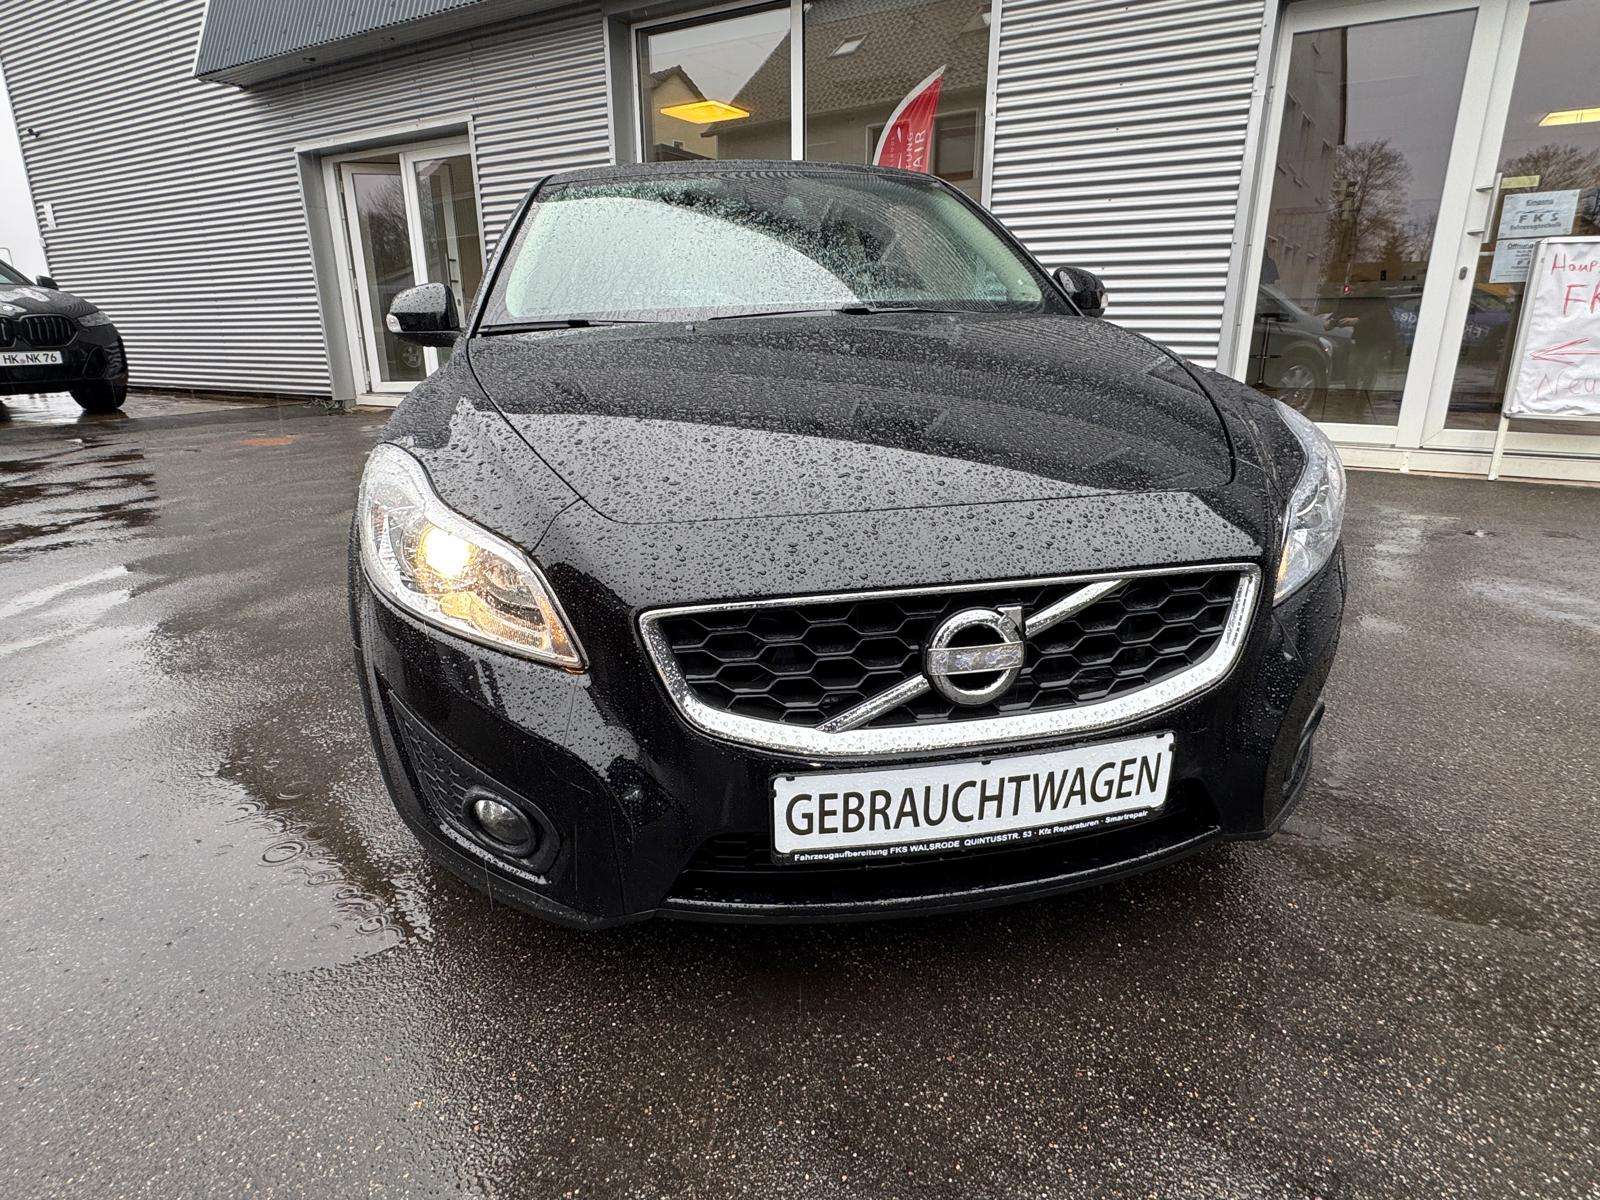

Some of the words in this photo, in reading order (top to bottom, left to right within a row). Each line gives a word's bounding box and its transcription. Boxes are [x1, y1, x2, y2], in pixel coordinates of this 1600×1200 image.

[1551, 253, 1600, 274] Haup
[3, 354, 19, 364] HK
[43, 353, 57, 361] 76
[785, 752, 1162, 836] GEBRAUCHTWAGEN
[794, 848, 888, 861] Fahrzeugaufbereitung
[890, 845, 908, 854] FKS
[910, 840, 960, 852] WALSRODE
[964, 831, 1020, 846] QUINTUSSTR.
[1038, 827, 1052, 836] Kfz
[1053, 819, 1100, 834] Reparaturen
[1105, 810, 1149, 824] Smartrepair
